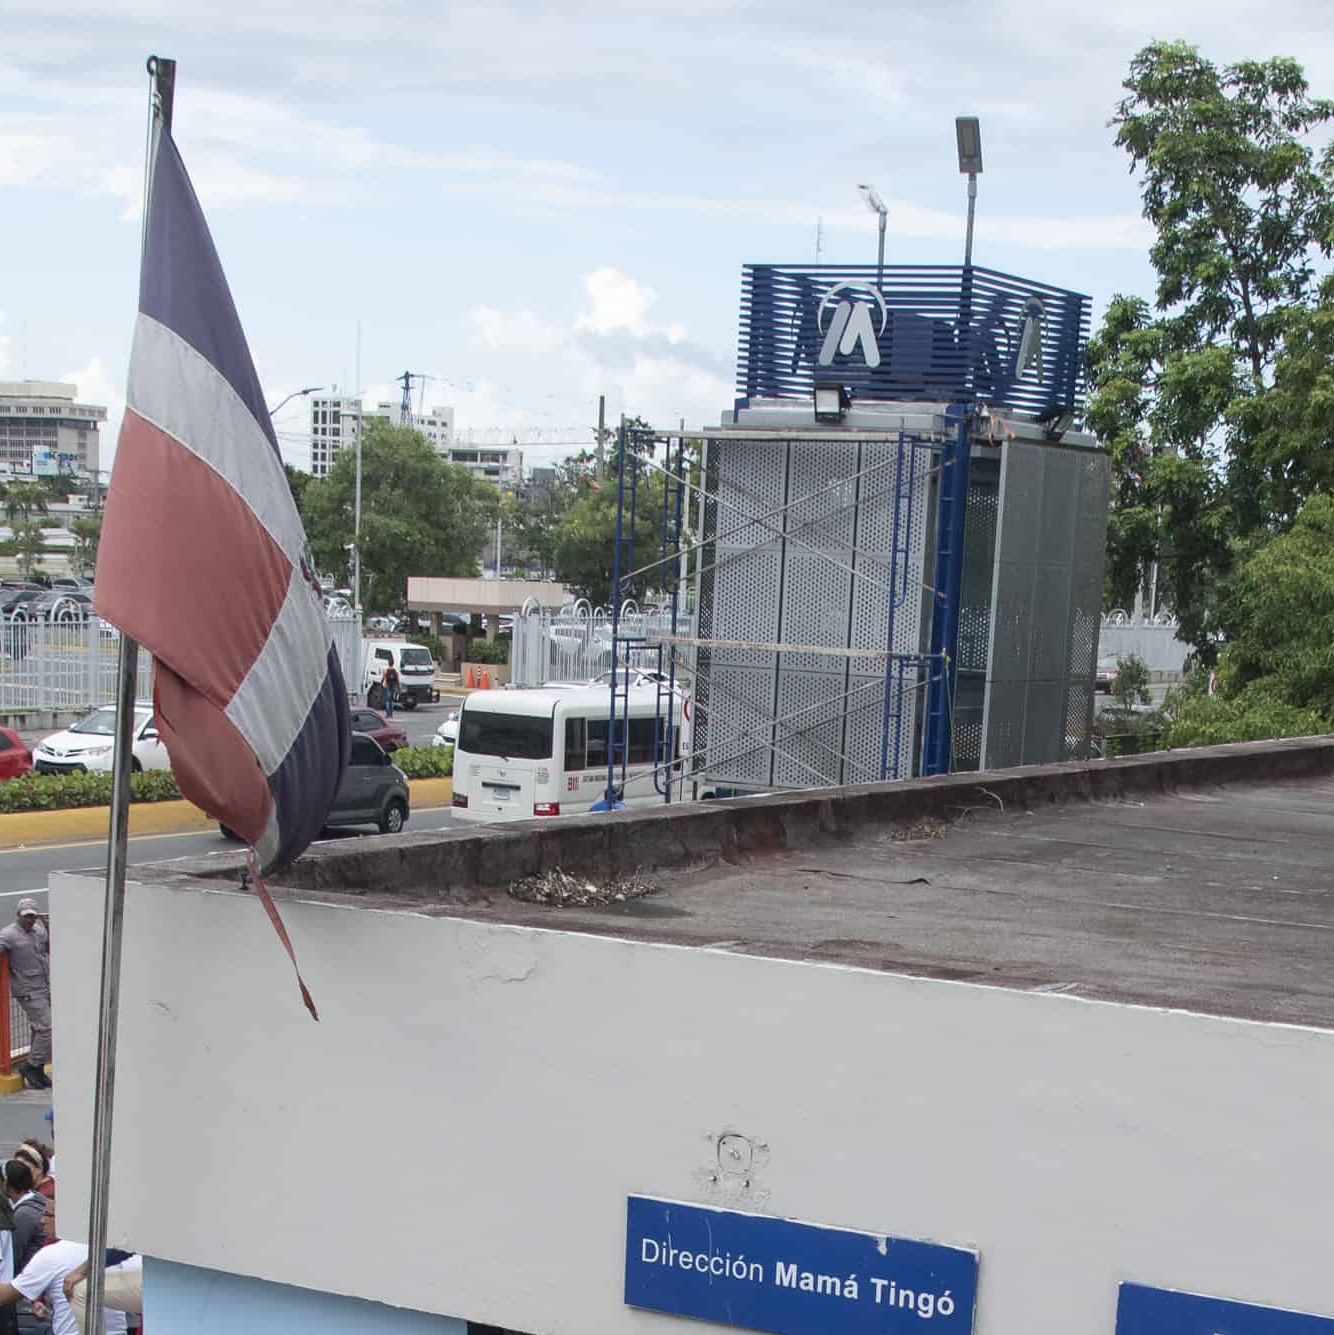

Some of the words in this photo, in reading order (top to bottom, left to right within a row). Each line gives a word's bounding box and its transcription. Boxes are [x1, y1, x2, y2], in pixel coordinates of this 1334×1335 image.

[641, 1237, 764, 1283] Dirección
[774, 1261, 859, 1300] Mamá
[869, 1276, 956, 1319] Tingó
